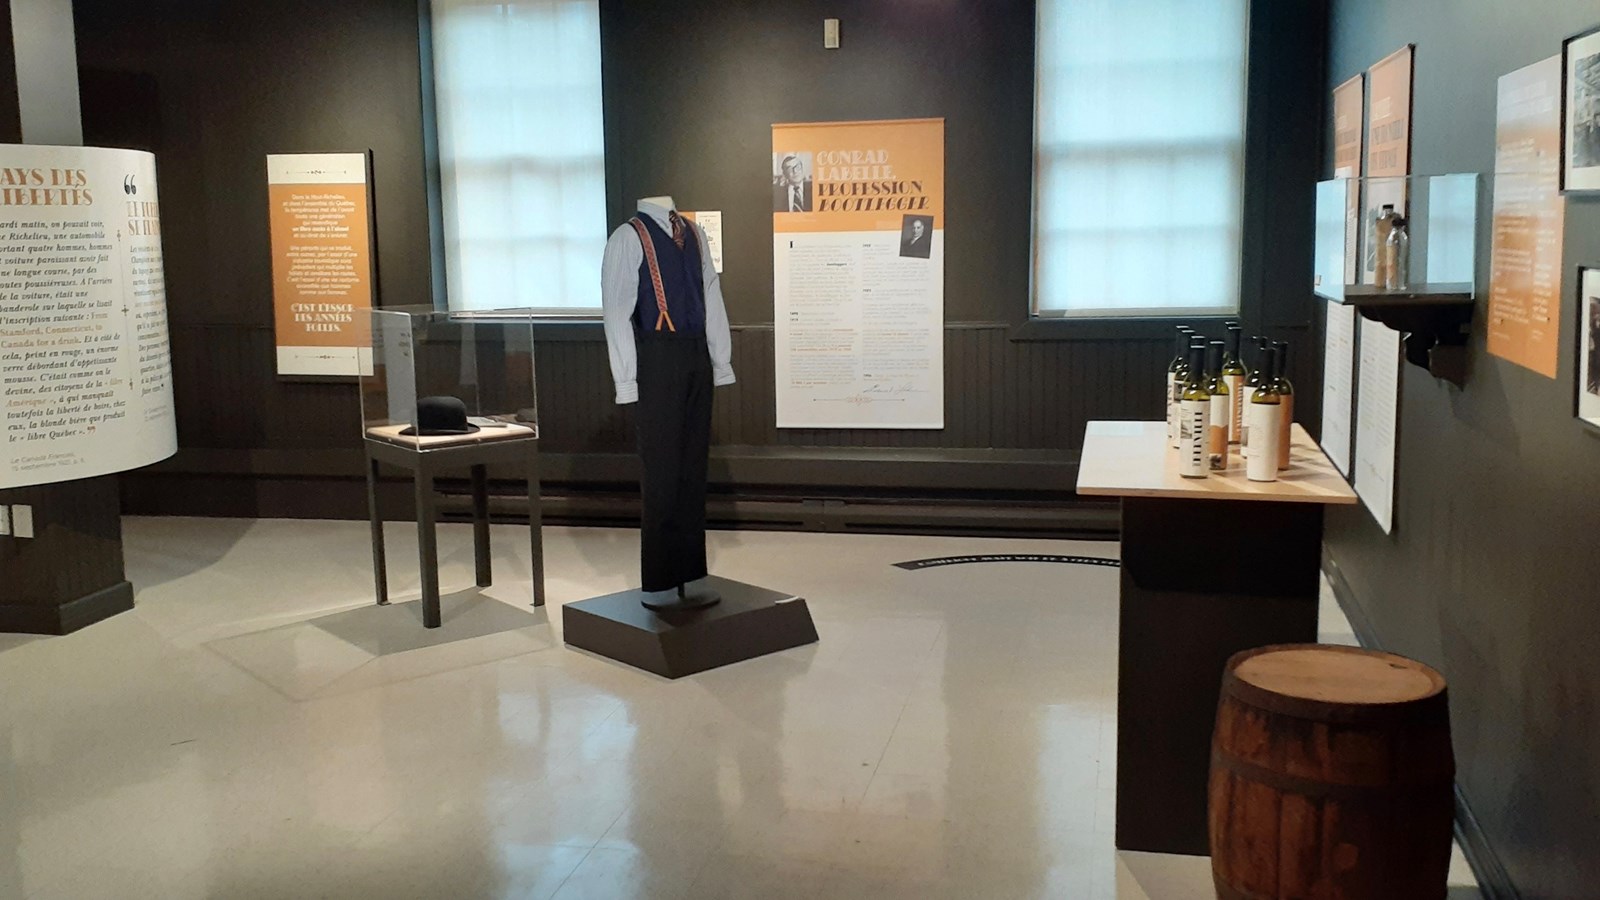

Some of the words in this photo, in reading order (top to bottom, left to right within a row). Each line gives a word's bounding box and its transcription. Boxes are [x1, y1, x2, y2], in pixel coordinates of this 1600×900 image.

[817, 150, 888, 165] CONRAD
[51, 169, 86, 186] DES
[0, 184, 93, 206] IBERTÉS
[818, 180, 922, 196] PROFESSION
[819, 196, 929, 211] BOOTLEGGER
[9, 233, 50, 241] Richelieu,
[70, 231, 105, 239] automobile
[28, 245, 53, 254] quatre
[56, 243, 87, 251] hommes,
[89, 243, 112, 251] hommes
[37, 256, 77, 266] paraissant
[97, 254, 109, 264] fait
[14, 269, 41, 278] longue
[72, 267, 84, 276] par
[87, 266, 97, 274] des
[10, 293, 18, 301] la
[0, 304, 39, 312] banderole
[57, 302, 86, 312] laquelle
[0, 328, 44, 336] Stamford,
[46, 326, 94, 334] Connecticut,
[1, 339, 34, 349] Canada
[37, 338, 48, 346] for
[84, 335, 92, 343] Et
[114, 332, 120, 340] de
[2, 352, 22, 360] cela,
[25, 351, 47, 361] peint
[61, 350, 83, 358] rouge,
[97, 345, 119, 353] énorme
[27, 361, 68, 371] débordant
[70, 356, 117, 367] d'appétissante
[40, 373, 67, 381] C'était
[69, 371, 94, 379] comme
[106, 367, 111, 375] le
[5, 388, 36, 396] devine,
[39, 385, 52, 393] des
[54, 383, 84, 392] citoyens
[86, 381, 94, 389] de
[6, 399, 47, 408] Amérique
[67, 394, 80, 404] qui
[82, 390, 114, 401] manquait
[7, 410, 43, 419] toutefois
[46, 408, 54, 416] la
[57, 406, 81, 415] liberté
[83, 404, 92, 412] de
[29, 421, 37, 429] la
[41, 418, 67, 428] blonde
[69, 417, 87, 425] bière
[89, 415, 101, 424] que
[103, 411, 125, 422] produit
[9, 434, 17, 442] le
[27, 432, 46, 441] libre
[49, 429, 77, 440] Québec
